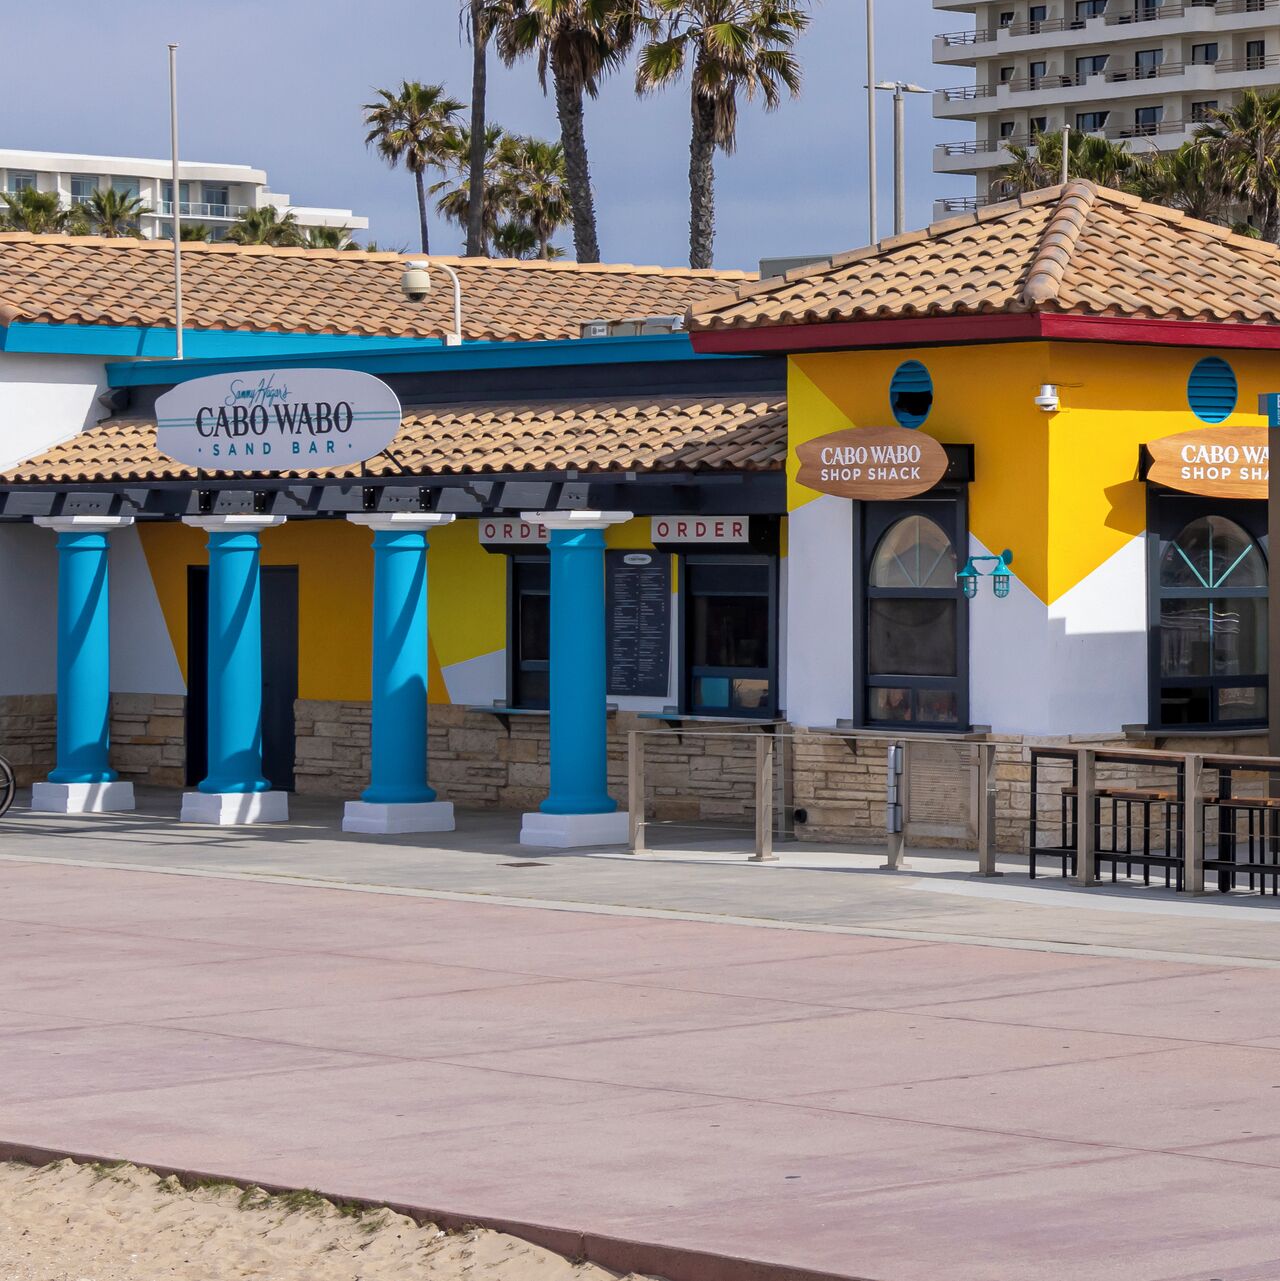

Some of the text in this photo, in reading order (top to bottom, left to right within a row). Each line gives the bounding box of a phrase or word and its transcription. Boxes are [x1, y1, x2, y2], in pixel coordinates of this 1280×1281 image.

[196, 401, 354, 438] CABO WABO
[213, 440, 335, 456] SAND BAR
[821, 444, 921, 465] CABO WABO
[1181, 444, 1269, 464] CABO WA
[821, 466, 921, 480] SHOP SHACK
[1181, 467, 1231, 480] SHOP
[484, 523, 547, 539] ORDE
[657, 521, 743, 538] ORDER
